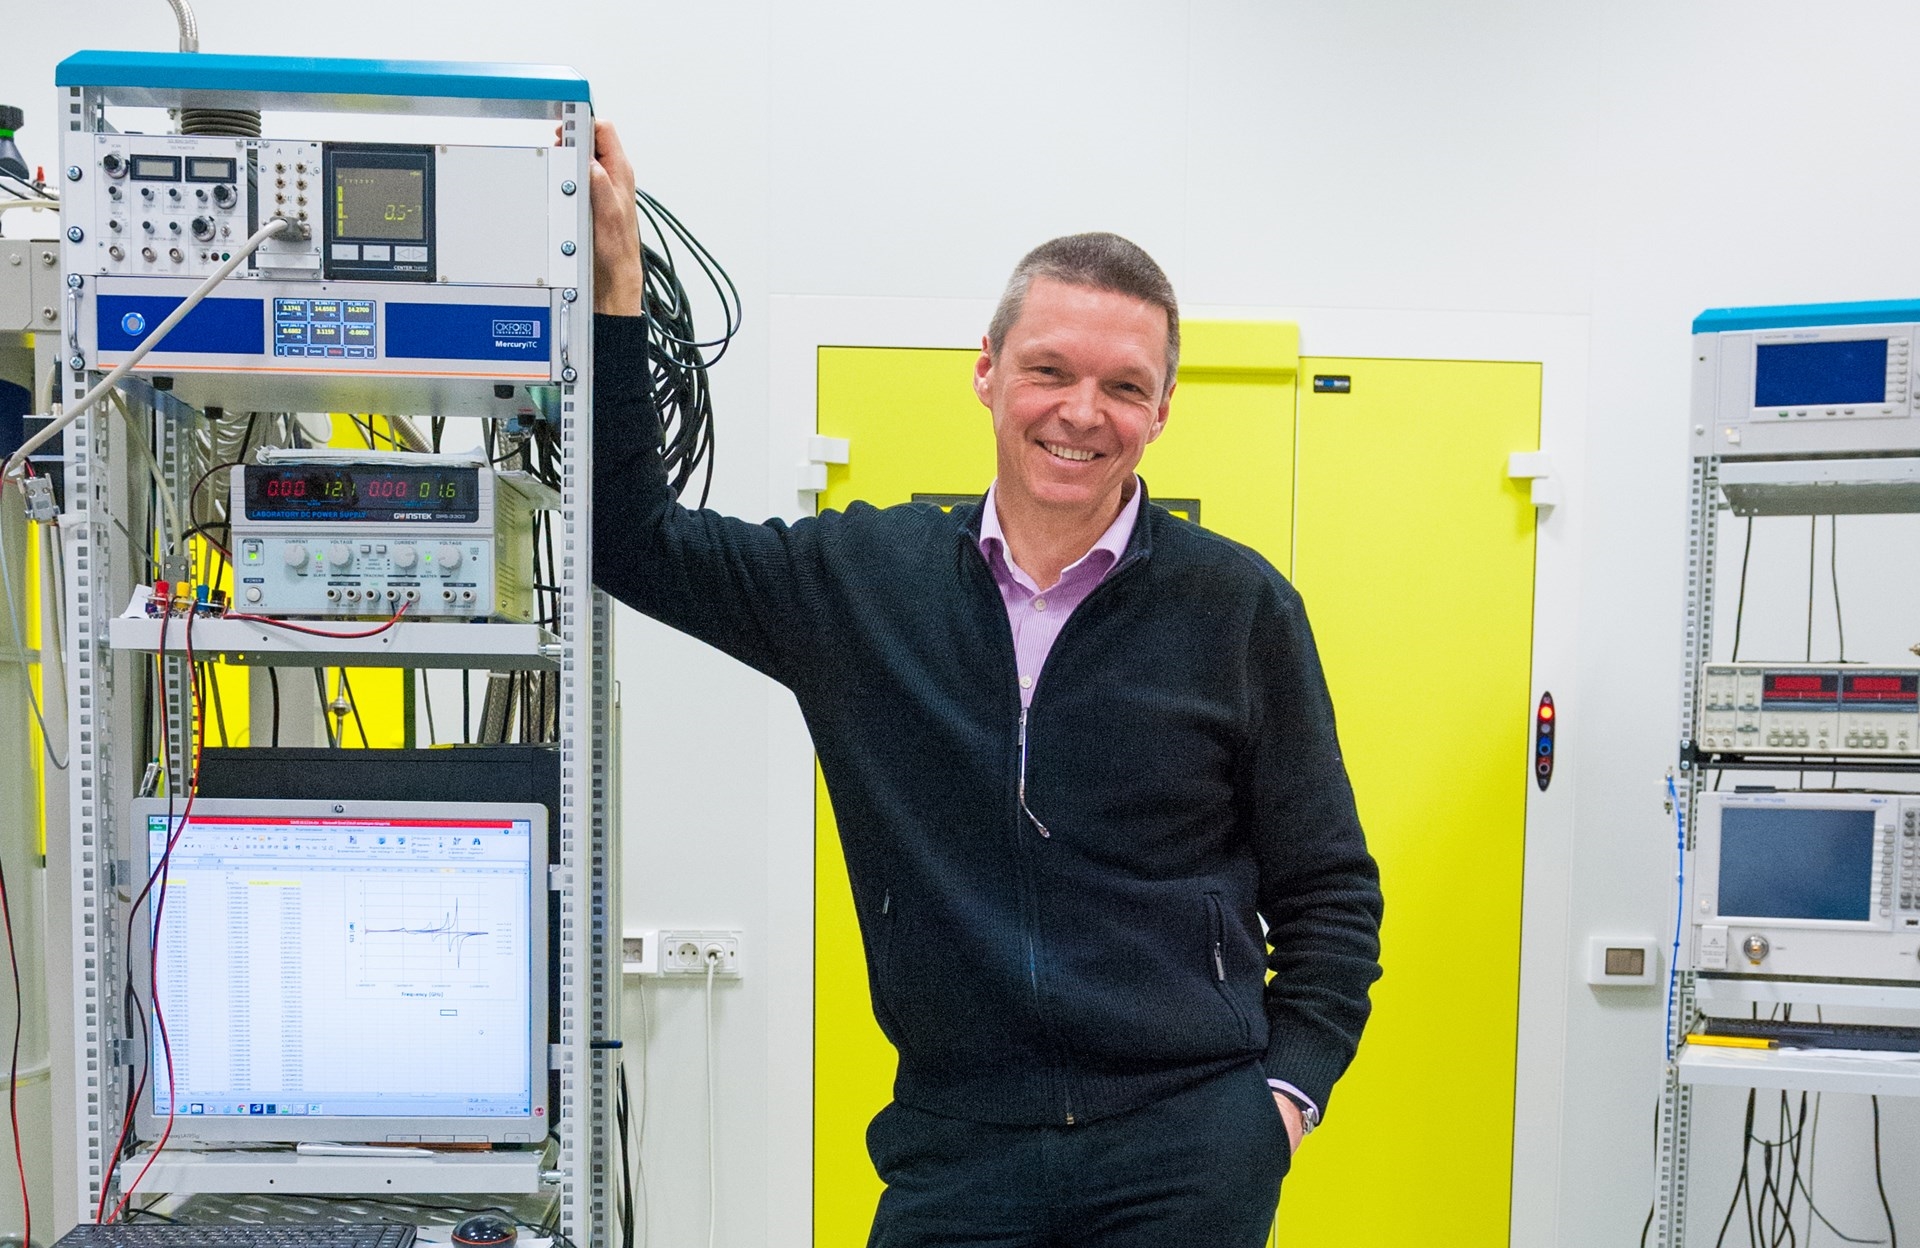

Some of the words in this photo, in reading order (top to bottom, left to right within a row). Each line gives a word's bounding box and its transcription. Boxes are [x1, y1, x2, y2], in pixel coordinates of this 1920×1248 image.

[495, 322, 532, 332] OXFORD
[251, 510, 300, 518] LABORATORY
[339, 511, 368, 519] SUPPLY
